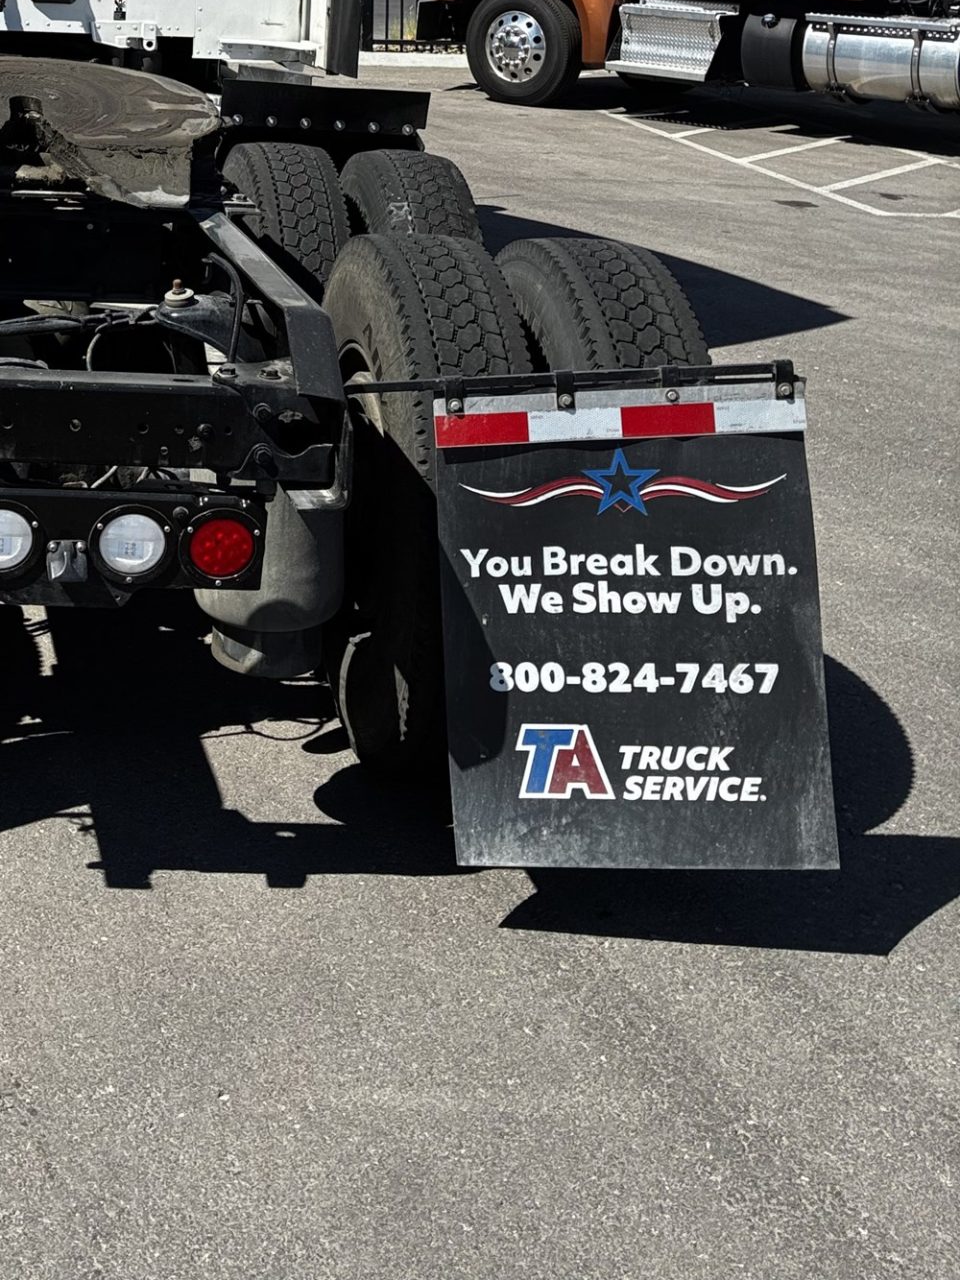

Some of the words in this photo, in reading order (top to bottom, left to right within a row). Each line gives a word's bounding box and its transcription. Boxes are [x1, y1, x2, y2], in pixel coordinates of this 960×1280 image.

[459, 548, 532, 578] You
[542, 543, 662, 577] Break
[670, 546, 798, 577] Down.
[498, 583, 564, 614] We
[572, 581, 682, 615] Show
[691, 583, 762, 624] Up.
[488, 661, 779, 695] 800-824-7467
[515, 723, 617, 800] TA
[618, 745, 735, 772] TRUCK
